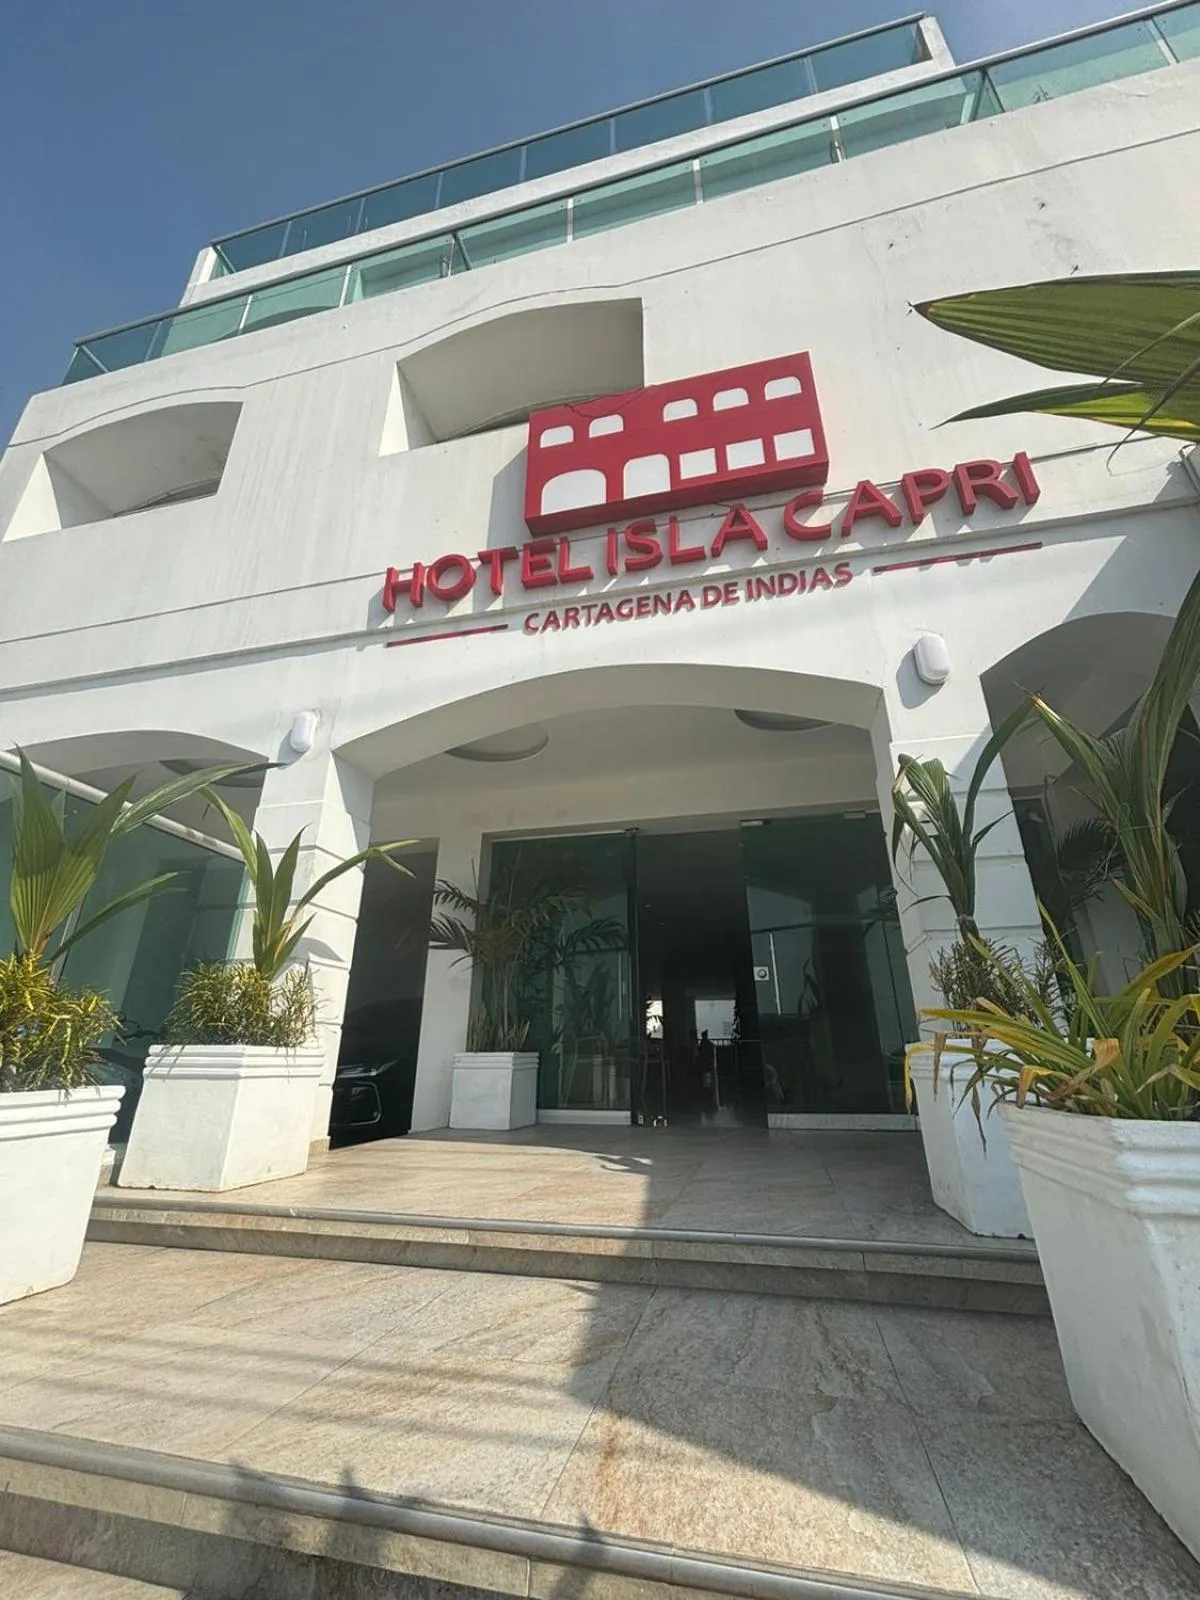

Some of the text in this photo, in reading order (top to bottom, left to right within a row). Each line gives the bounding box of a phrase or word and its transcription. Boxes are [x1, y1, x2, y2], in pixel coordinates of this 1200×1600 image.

[383, 451, 1041, 611] HOTEL ISLA CAPRI
[525, 562, 853, 633] CARTAGENA DE INDIAS
